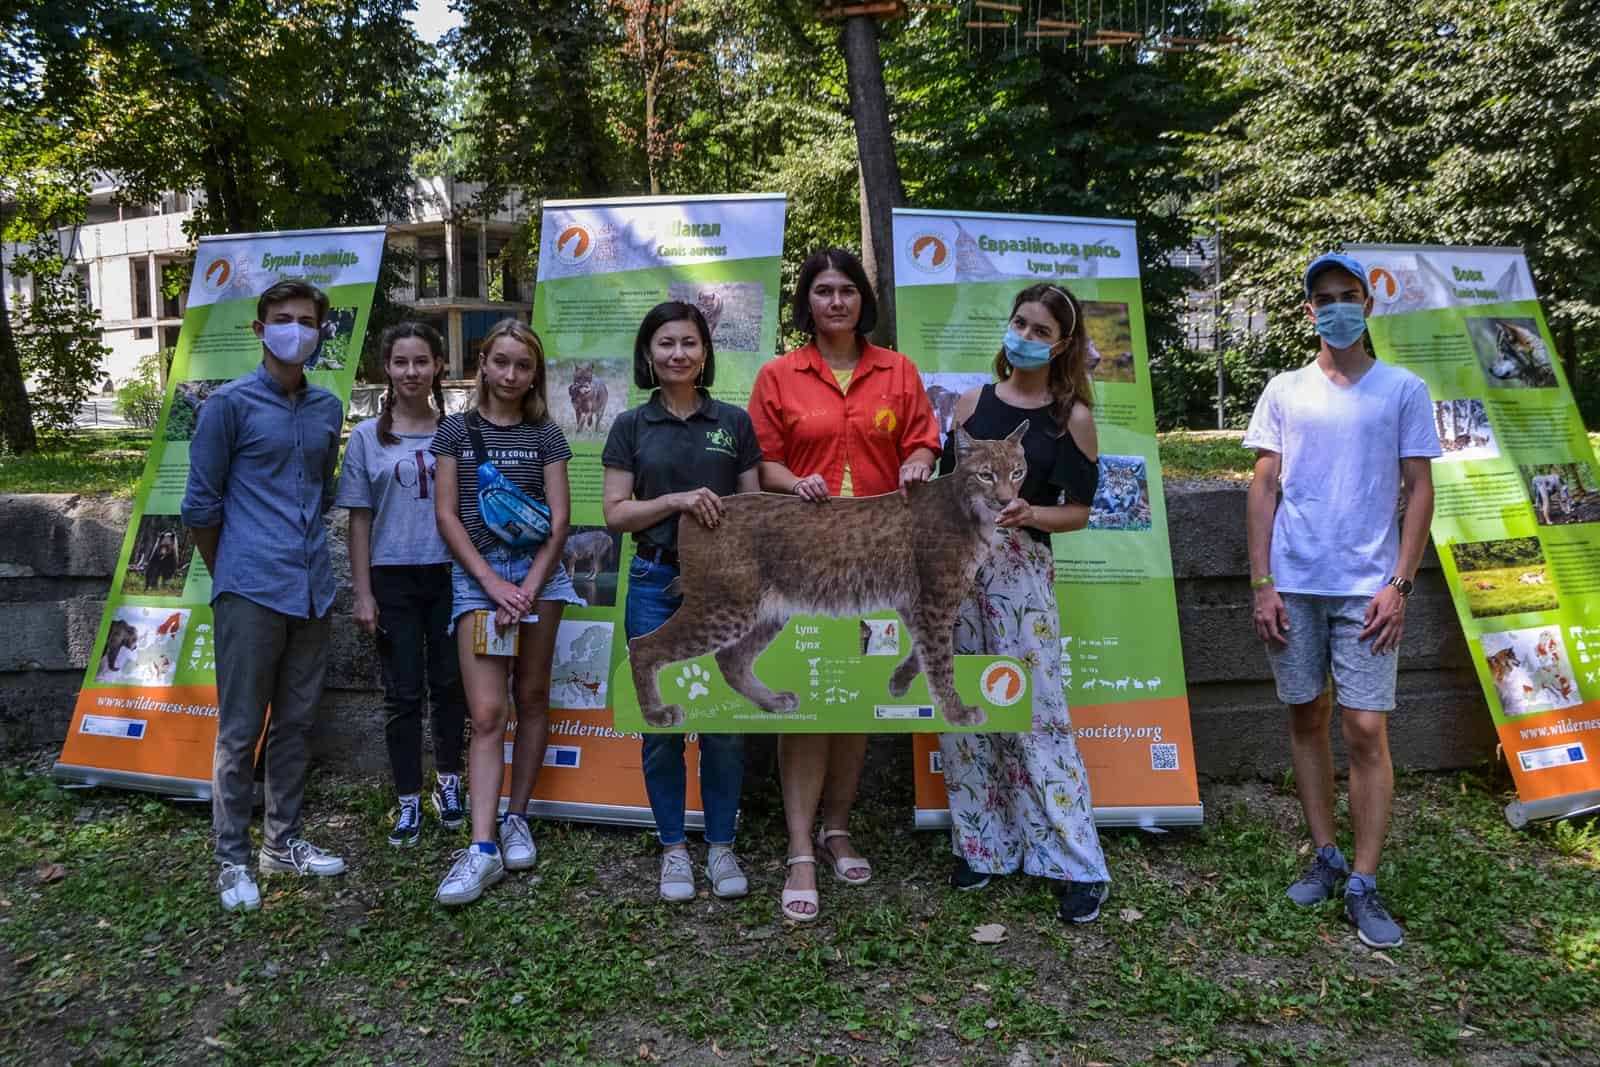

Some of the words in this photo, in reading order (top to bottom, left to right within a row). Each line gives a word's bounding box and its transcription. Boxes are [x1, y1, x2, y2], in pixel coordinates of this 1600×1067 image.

[978, 234, 1079, 256] Євразійська
[261, 251, 301, 272] Бурий
[795, 623, 819, 639] Lynx
[795, 639, 821, 653] Lynx
[97, 695, 220, 717] www.wilderness-societ
